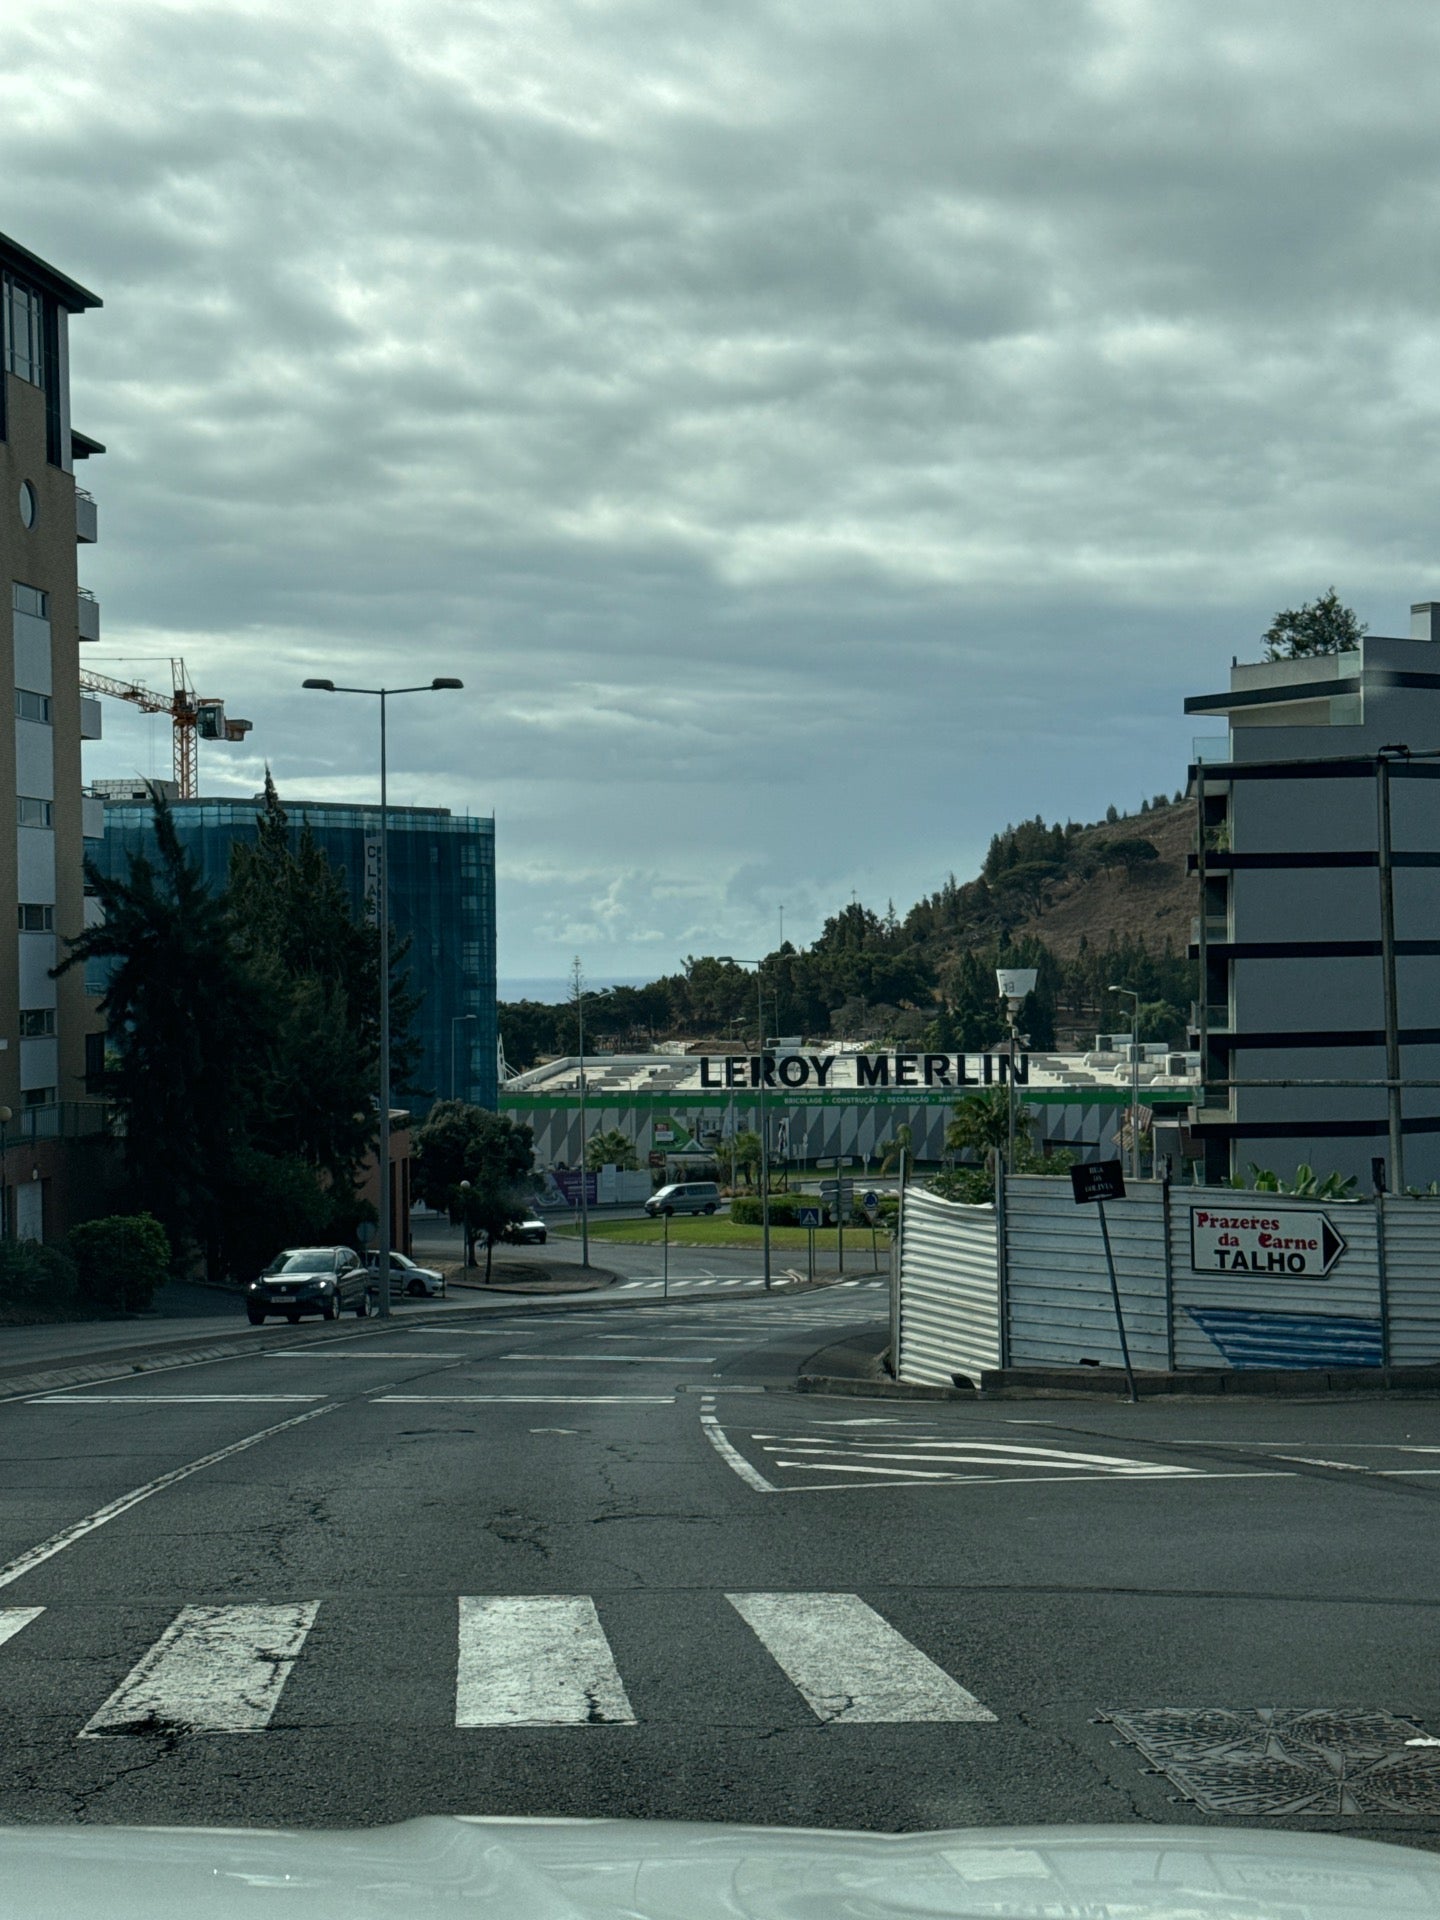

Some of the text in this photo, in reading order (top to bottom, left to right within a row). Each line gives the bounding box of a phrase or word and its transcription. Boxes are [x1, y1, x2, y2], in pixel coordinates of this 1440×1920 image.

[700, 1054, 1029, 1087] LEROY MERLIN
[784, 1097, 823, 1105] BRICOLAGE
[832, 1095, 879, 1105] CONSTRUÇÃO
[887, 1095, 930, 1105] DECORAÇÃO
[1195, 1211, 1280, 1231] Prazeres
[1218, 1232, 1318, 1250] da Carne
[1214, 1249, 1306, 1273] TALHO
